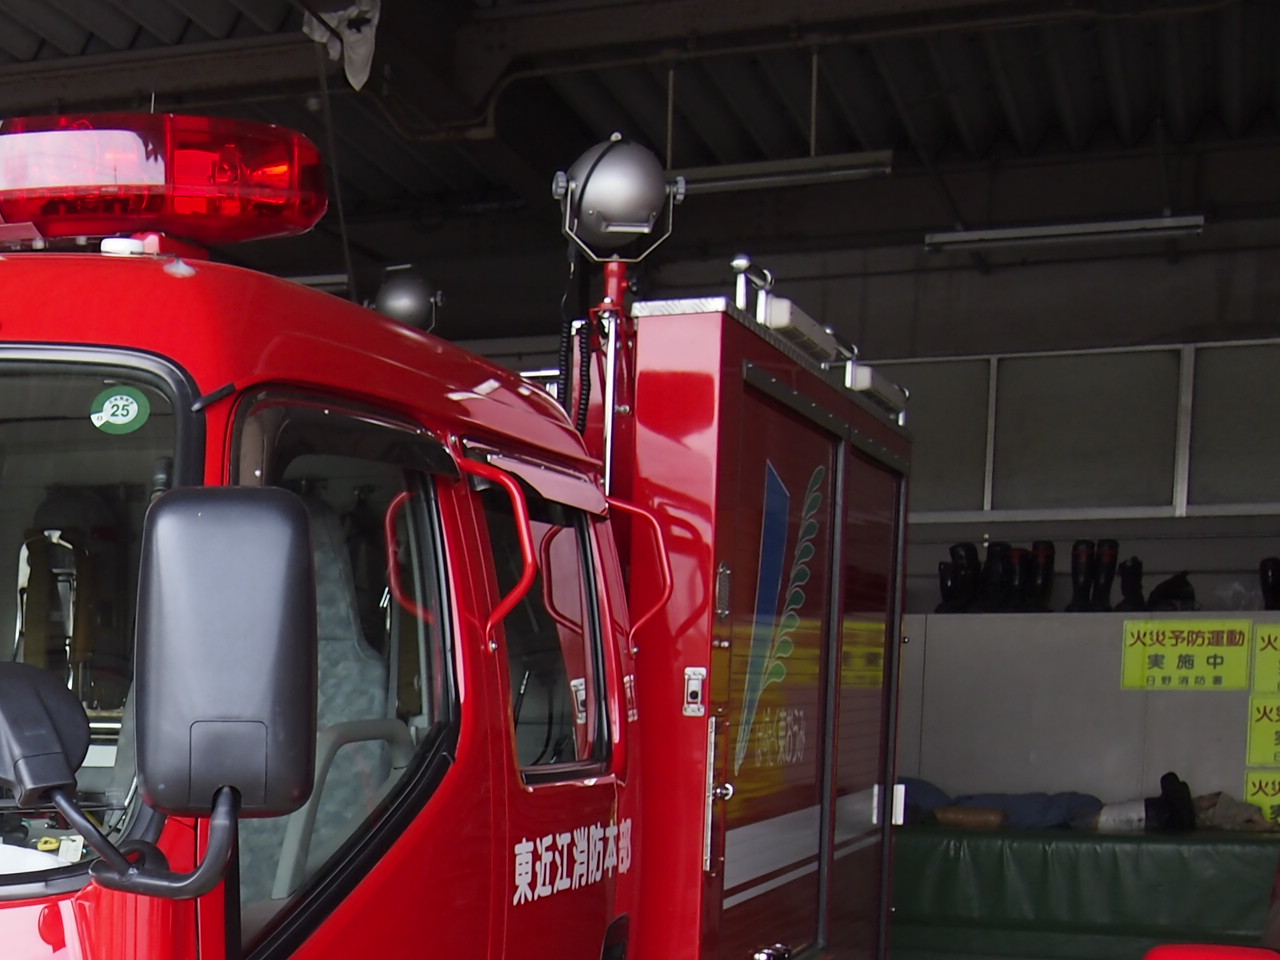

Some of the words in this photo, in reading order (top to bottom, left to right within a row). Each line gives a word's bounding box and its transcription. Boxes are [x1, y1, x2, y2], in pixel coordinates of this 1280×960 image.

[110, 404, 130, 418] 25
[1129, 629, 1246, 648] 火災予防運動
[512, 817, 632, 906] 東近江消防本部
